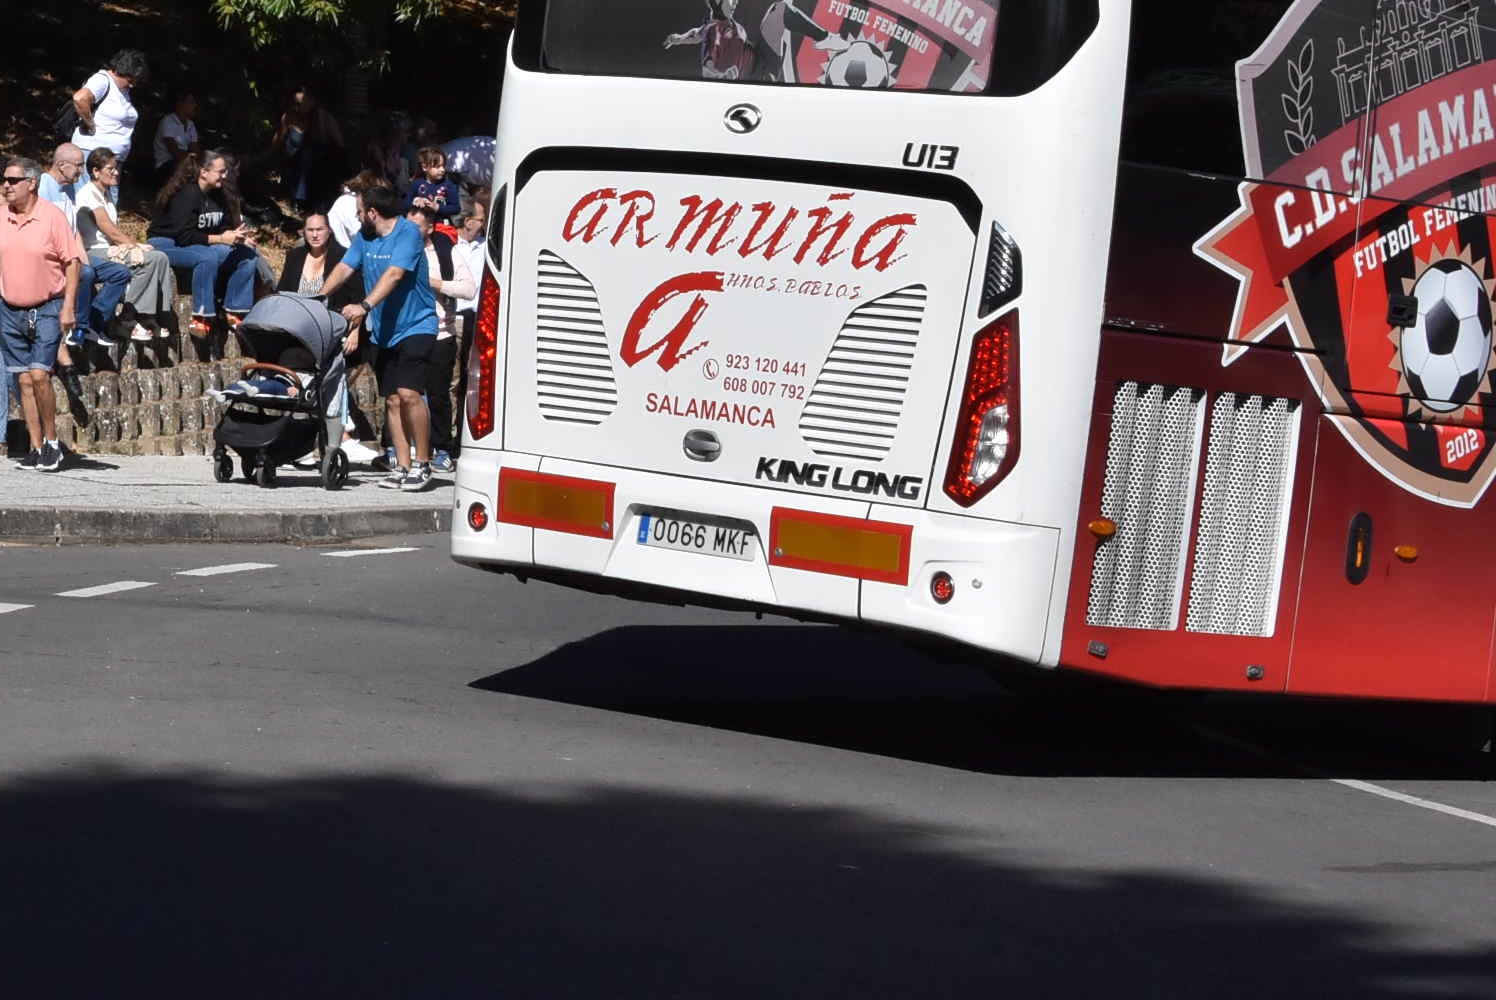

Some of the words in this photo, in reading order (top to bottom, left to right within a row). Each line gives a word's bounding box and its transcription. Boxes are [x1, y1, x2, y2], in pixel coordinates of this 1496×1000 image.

[828, 0, 870, 26] FUTBOL
[872, 15, 929, 54] FEMENINO
[902, 142, 959, 170] U13
[1273, 84, 1496, 250] C.D.SALAMA
[1352, 219, 1421, 279] FUTBOL
[725, 354, 750, 370] 923
[755, 357, 778, 374] 120
[782, 360, 807, 377] 441
[723, 376, 747, 393] 608
[751, 379, 777, 396] 007
[780, 383, 805, 400] 792
[645, 392, 777, 429] SALAMANCA
[1445, 428, 1480, 465] 2012
[755, 456, 830, 488] KING
[831, 466, 923, 501] LONG
[653, 518, 707, 549] 0066
[712, 527, 756, 556] MKF
